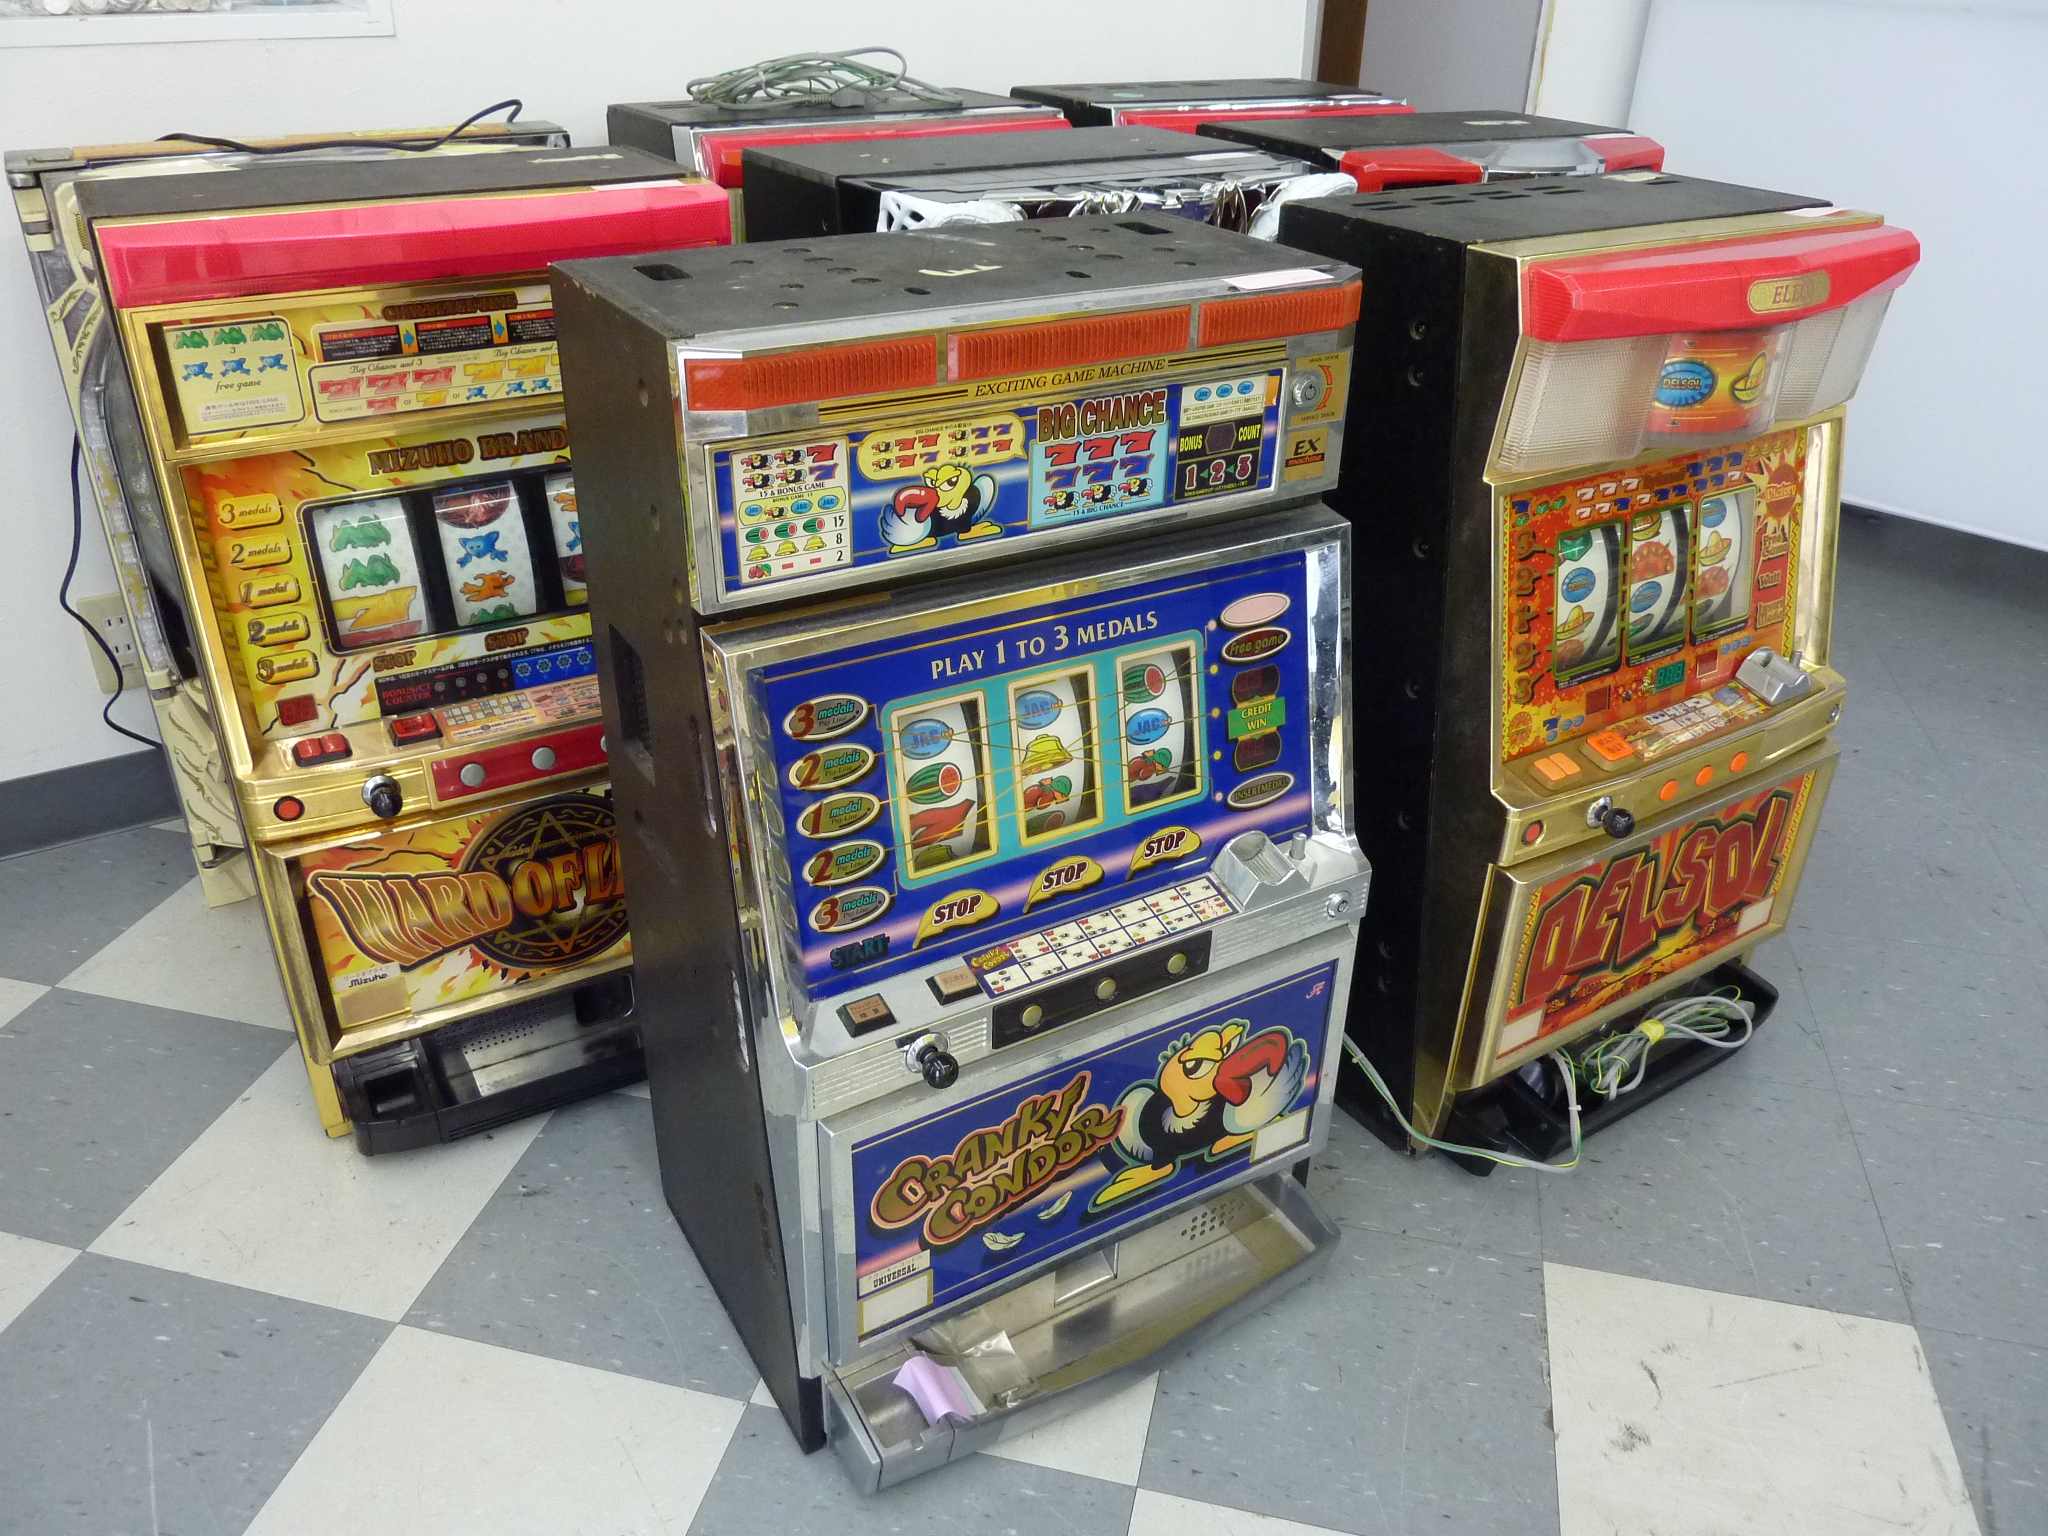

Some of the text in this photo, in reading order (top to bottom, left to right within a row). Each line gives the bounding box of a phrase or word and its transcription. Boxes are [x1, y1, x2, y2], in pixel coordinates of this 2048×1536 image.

[494, 348, 508, 358] Big
[350, 364, 366, 375] Big
[400, 360, 413, 368] and
[417, 358, 423, 366] 3
[215, 379, 262, 394] free game
[975, 358, 1166, 397] EXCITING GAME MACHINE
[1662, 378, 1702, 390] DELSOL
[1037, 389, 1168, 444] BIG CHANCE
[1179, 423, 1261, 452] BONUS COUNT
[1292, 436, 1322, 457] EX
[369, 426, 568, 477] MIZUHO BRAND
[1287, 454, 1322, 467] machine
[1185, 463, 1198, 490] 1
[1209, 458, 1226, 485] 2
[1236, 453, 1252, 480] 3
[777, 486, 803, 495] BONUS
[804, 481, 826, 491] GAME
[219, 502, 272, 521] 3 medals
[796, 503, 808, 511] JAC
[823, 498, 835, 506] JAC
[1087, 506, 1098, 514] BIG
[1099, 501, 1124, 511] CHANCE
[833, 515, 845, 528] 15
[835, 532, 843, 545] 8
[1514, 527, 1534, 560] 3
[230, 543, 281, 565] 2 medals
[836, 550, 844, 562] 2
[1514, 565, 1534, 596] 2
[240, 582, 288, 604] 1 medal
[248, 620, 300, 643] 2 medals
[485, 628, 529, 651] STOP
[1254, 633, 1285, 651] game
[930, 611, 1158, 680] PLAY 1 TO 3 MEDALS
[256, 658, 274, 681] 3
[372, 649, 417, 672] STOP
[382, 682, 432, 699] BONUS/CT
[385, 690, 432, 706] COUNTER
[1024, 701, 1050, 717] JAC
[1241, 702, 1273, 720] CREDIT
[791, 701, 856, 739] 3 medals
[818, 713, 847, 728] Pay Line
[1136, 716, 1162, 733] JAC
[1246, 717, 1268, 732] WIN
[911, 728, 943, 747] JAC
[798, 750, 861, 788] 2 medals
[825, 765, 853, 778] Pay Line
[810, 799, 863, 837] 1 medal
[831, 812, 858, 826] Pay Line
[1143, 829, 1187, 860] STOP
[812, 846, 871, 886] 2 medals
[837, 859, 864, 873] Pay Line
[1040, 858, 1088, 891] STOP
[319, 871, 514, 967] WARD
[513, 852, 584, 917] OF
[817, 892, 878, 931] 3 medals
[843, 906, 870, 919] Pay Line
[931, 893, 984, 927] STOP
[830, 934, 891, 971] START
[348, 973, 388, 988] Mizuho
[875, 1071, 1088, 1226] CRANKY
[926, 1106, 1124, 1240] CONDOR
[873, 1263, 917, 1288] UNIVERSAL
